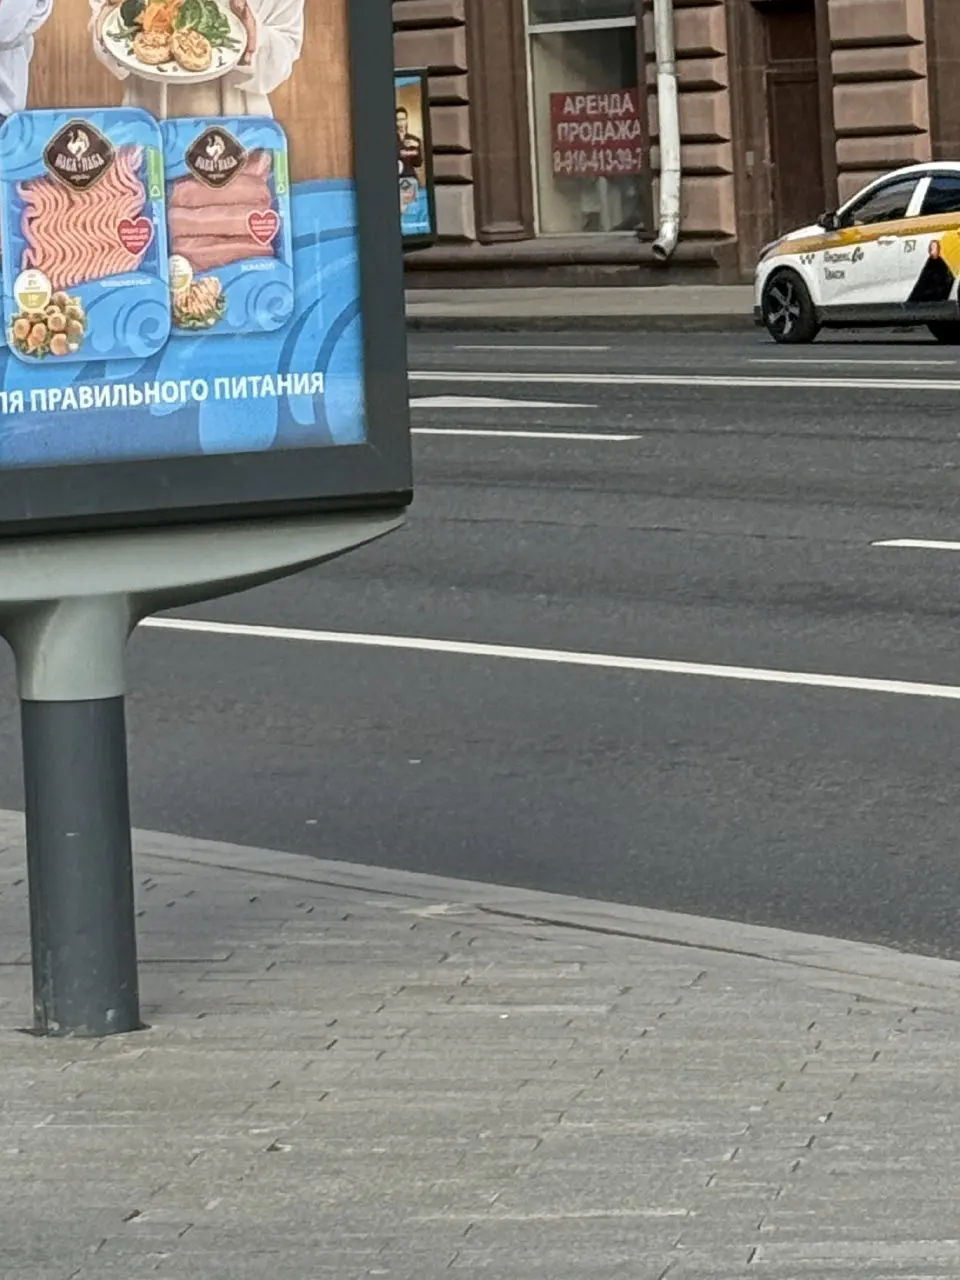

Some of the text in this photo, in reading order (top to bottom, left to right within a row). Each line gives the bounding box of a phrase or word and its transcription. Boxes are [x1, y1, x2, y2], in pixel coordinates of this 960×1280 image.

[563, 93, 634, 117] АРЕНДА
[557, 120, 640, 144] ПРОДАЖА
[31, 378, 208, 412] ПРАВИЛЬНОГО
[214, 372, 325, 401] ПИТАНИЯ
